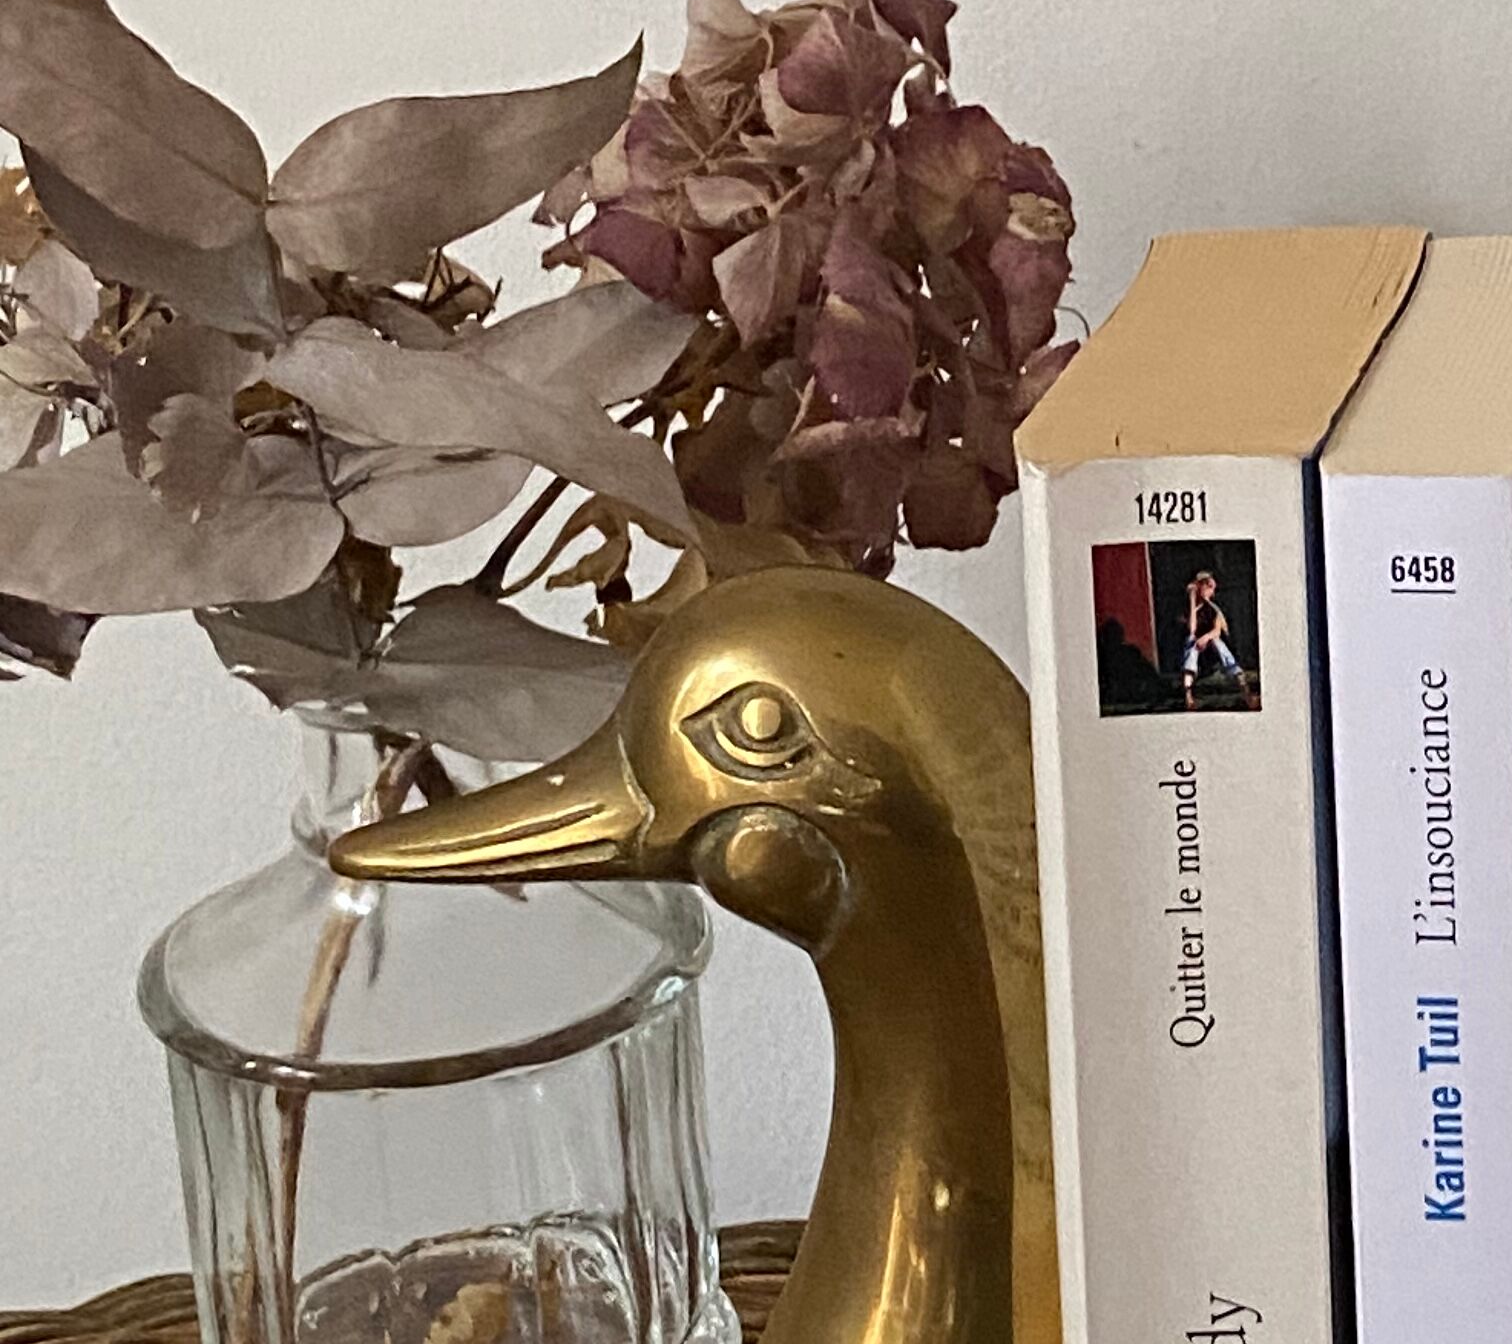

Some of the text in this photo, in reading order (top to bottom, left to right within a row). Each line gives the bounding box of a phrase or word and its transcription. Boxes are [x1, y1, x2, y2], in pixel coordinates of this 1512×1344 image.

[1134, 491, 1208, 525] 14281
[1391, 555, 1456, 583] 6458
[1158, 760, 1216, 1048] Quitter le monde
[1408, 668, 1458, 947] L'insouciance
[1416, 996, 1466, 1222] Karine Tuil
